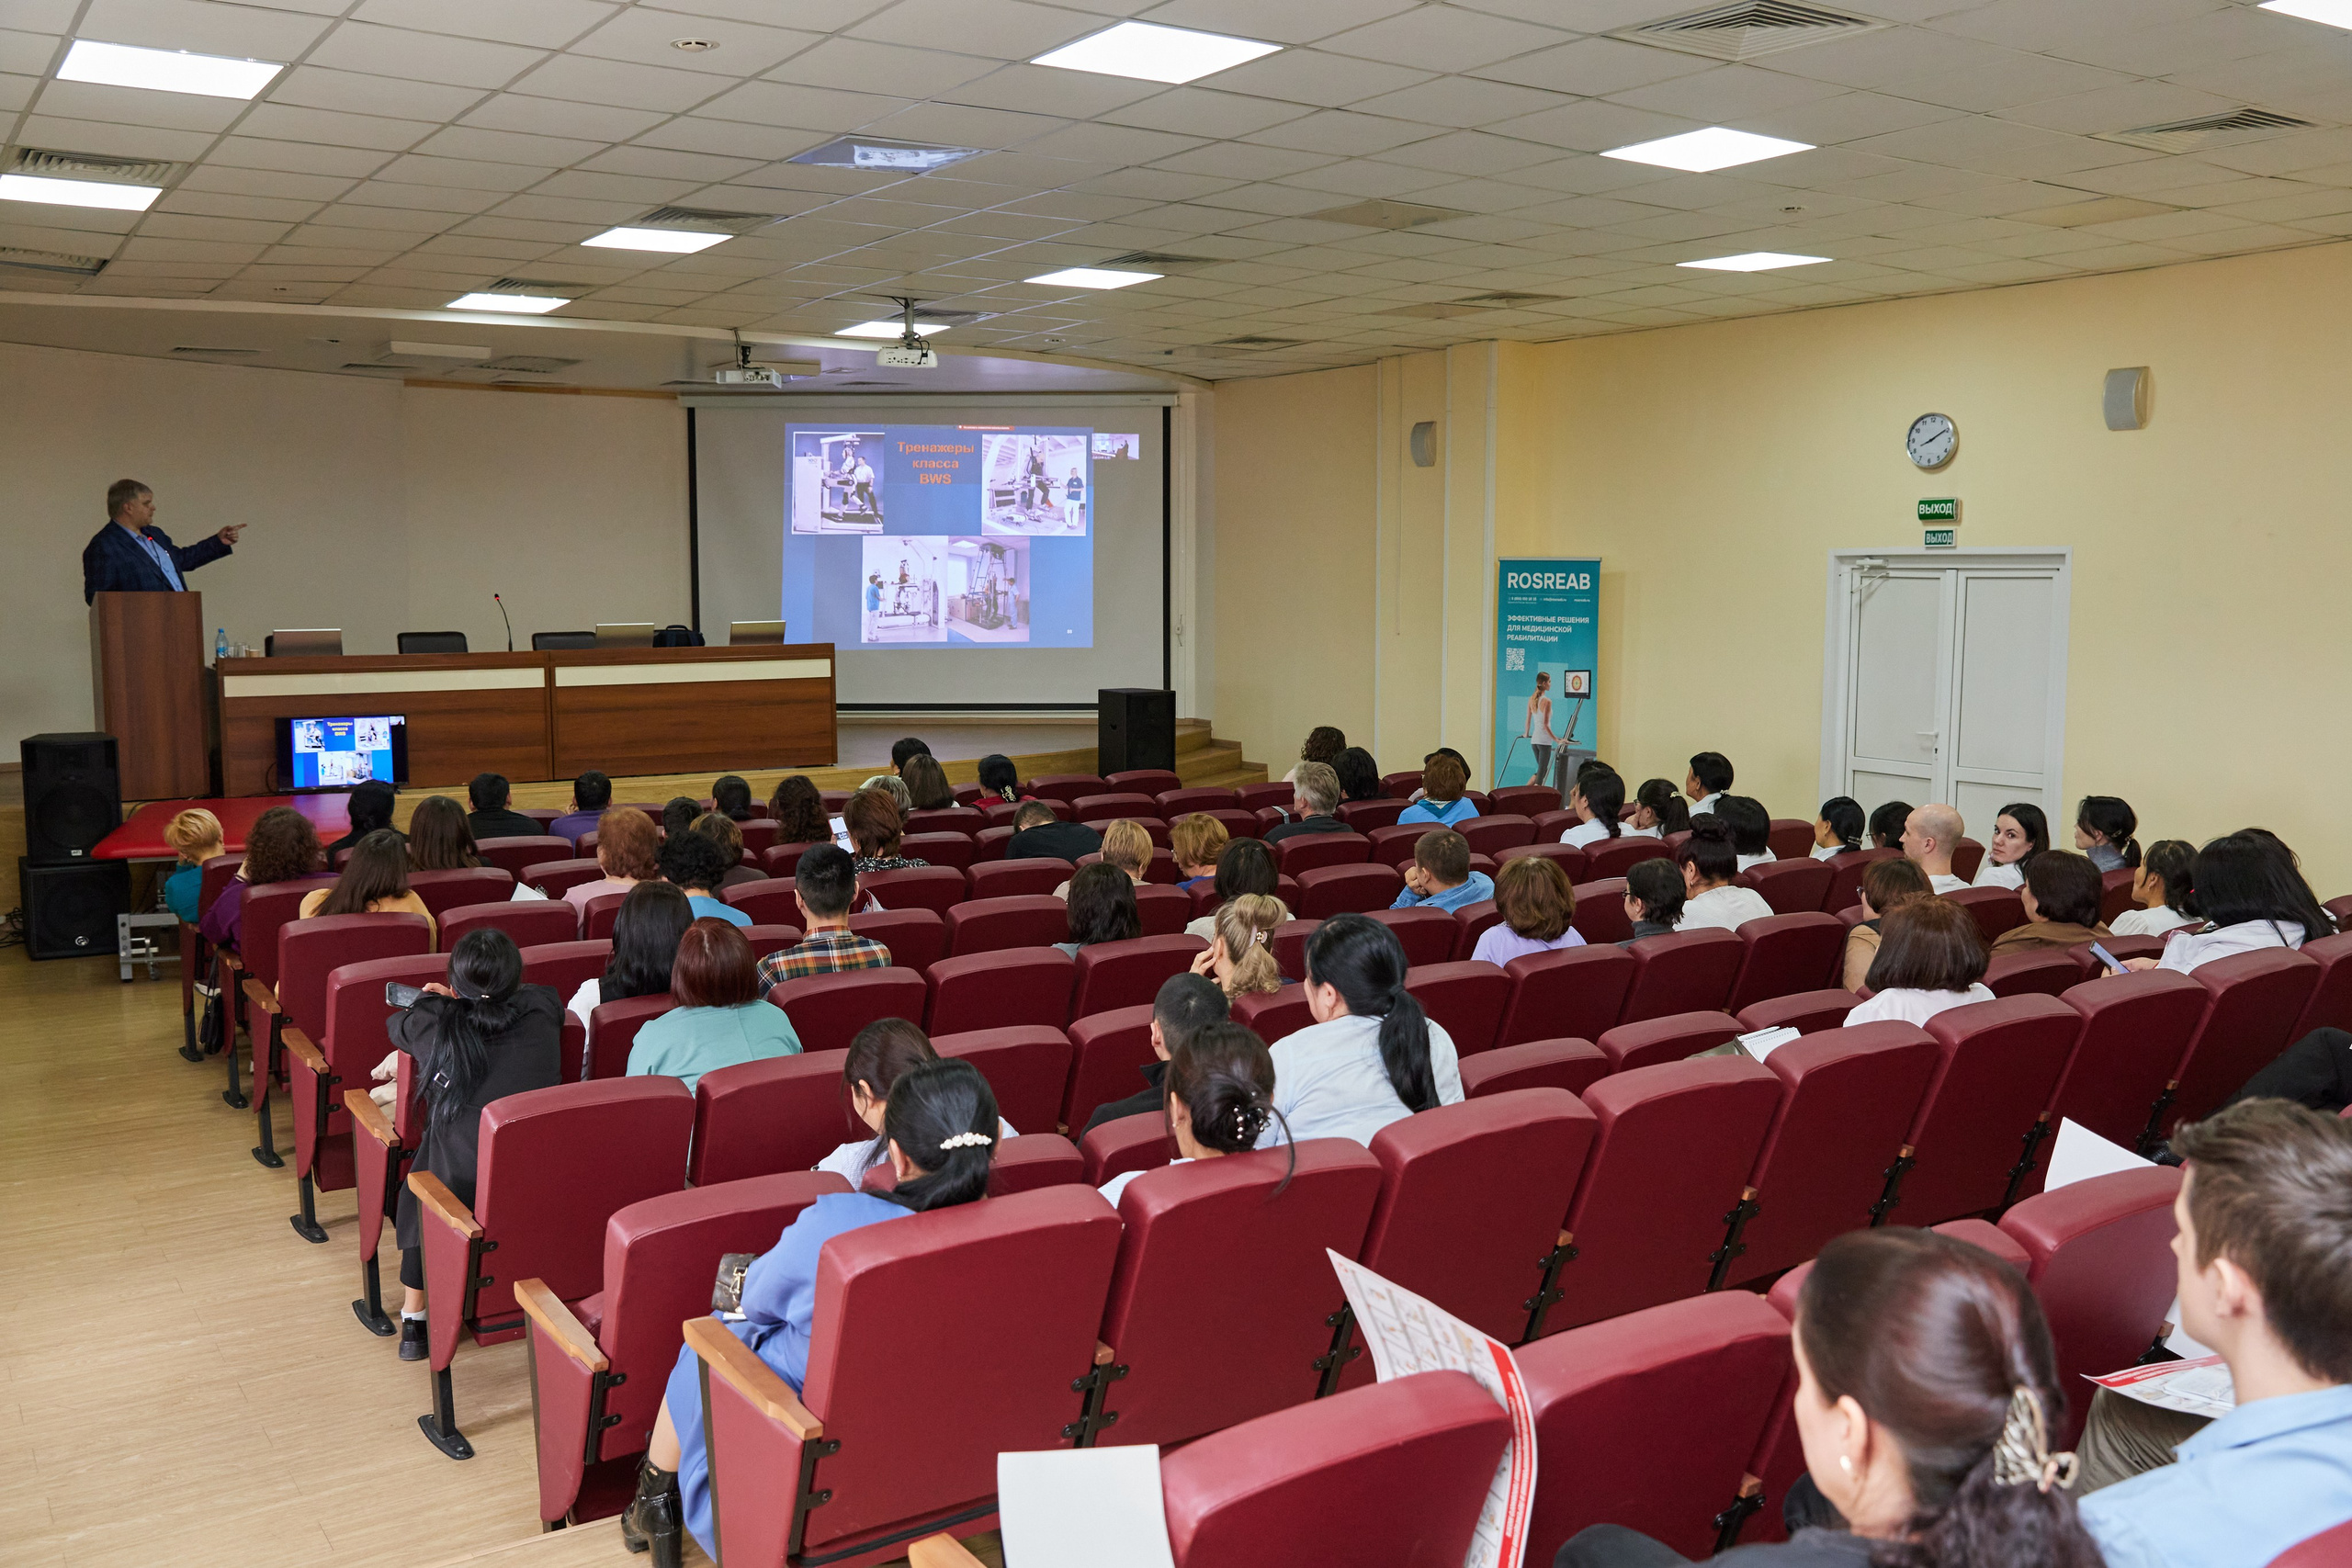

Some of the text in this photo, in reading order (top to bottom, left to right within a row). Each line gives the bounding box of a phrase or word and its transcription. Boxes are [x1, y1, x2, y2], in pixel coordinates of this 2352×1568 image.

[897, 441, 974, 455] Тренажеры
[912, 459, 959, 468] класса
[920, 473, 952, 484] BWS
[1919, 502, 1952, 515] ВЫХОД
[1926, 532, 1952, 545] ВЫХОД
[1507, 572, 1590, 590] ROSREAB
[1521, 625, 1572, 633] МЕДИЦИНСКОЙ
[1507, 635, 1558, 643] РЕАБИЛИТАЦИИ
